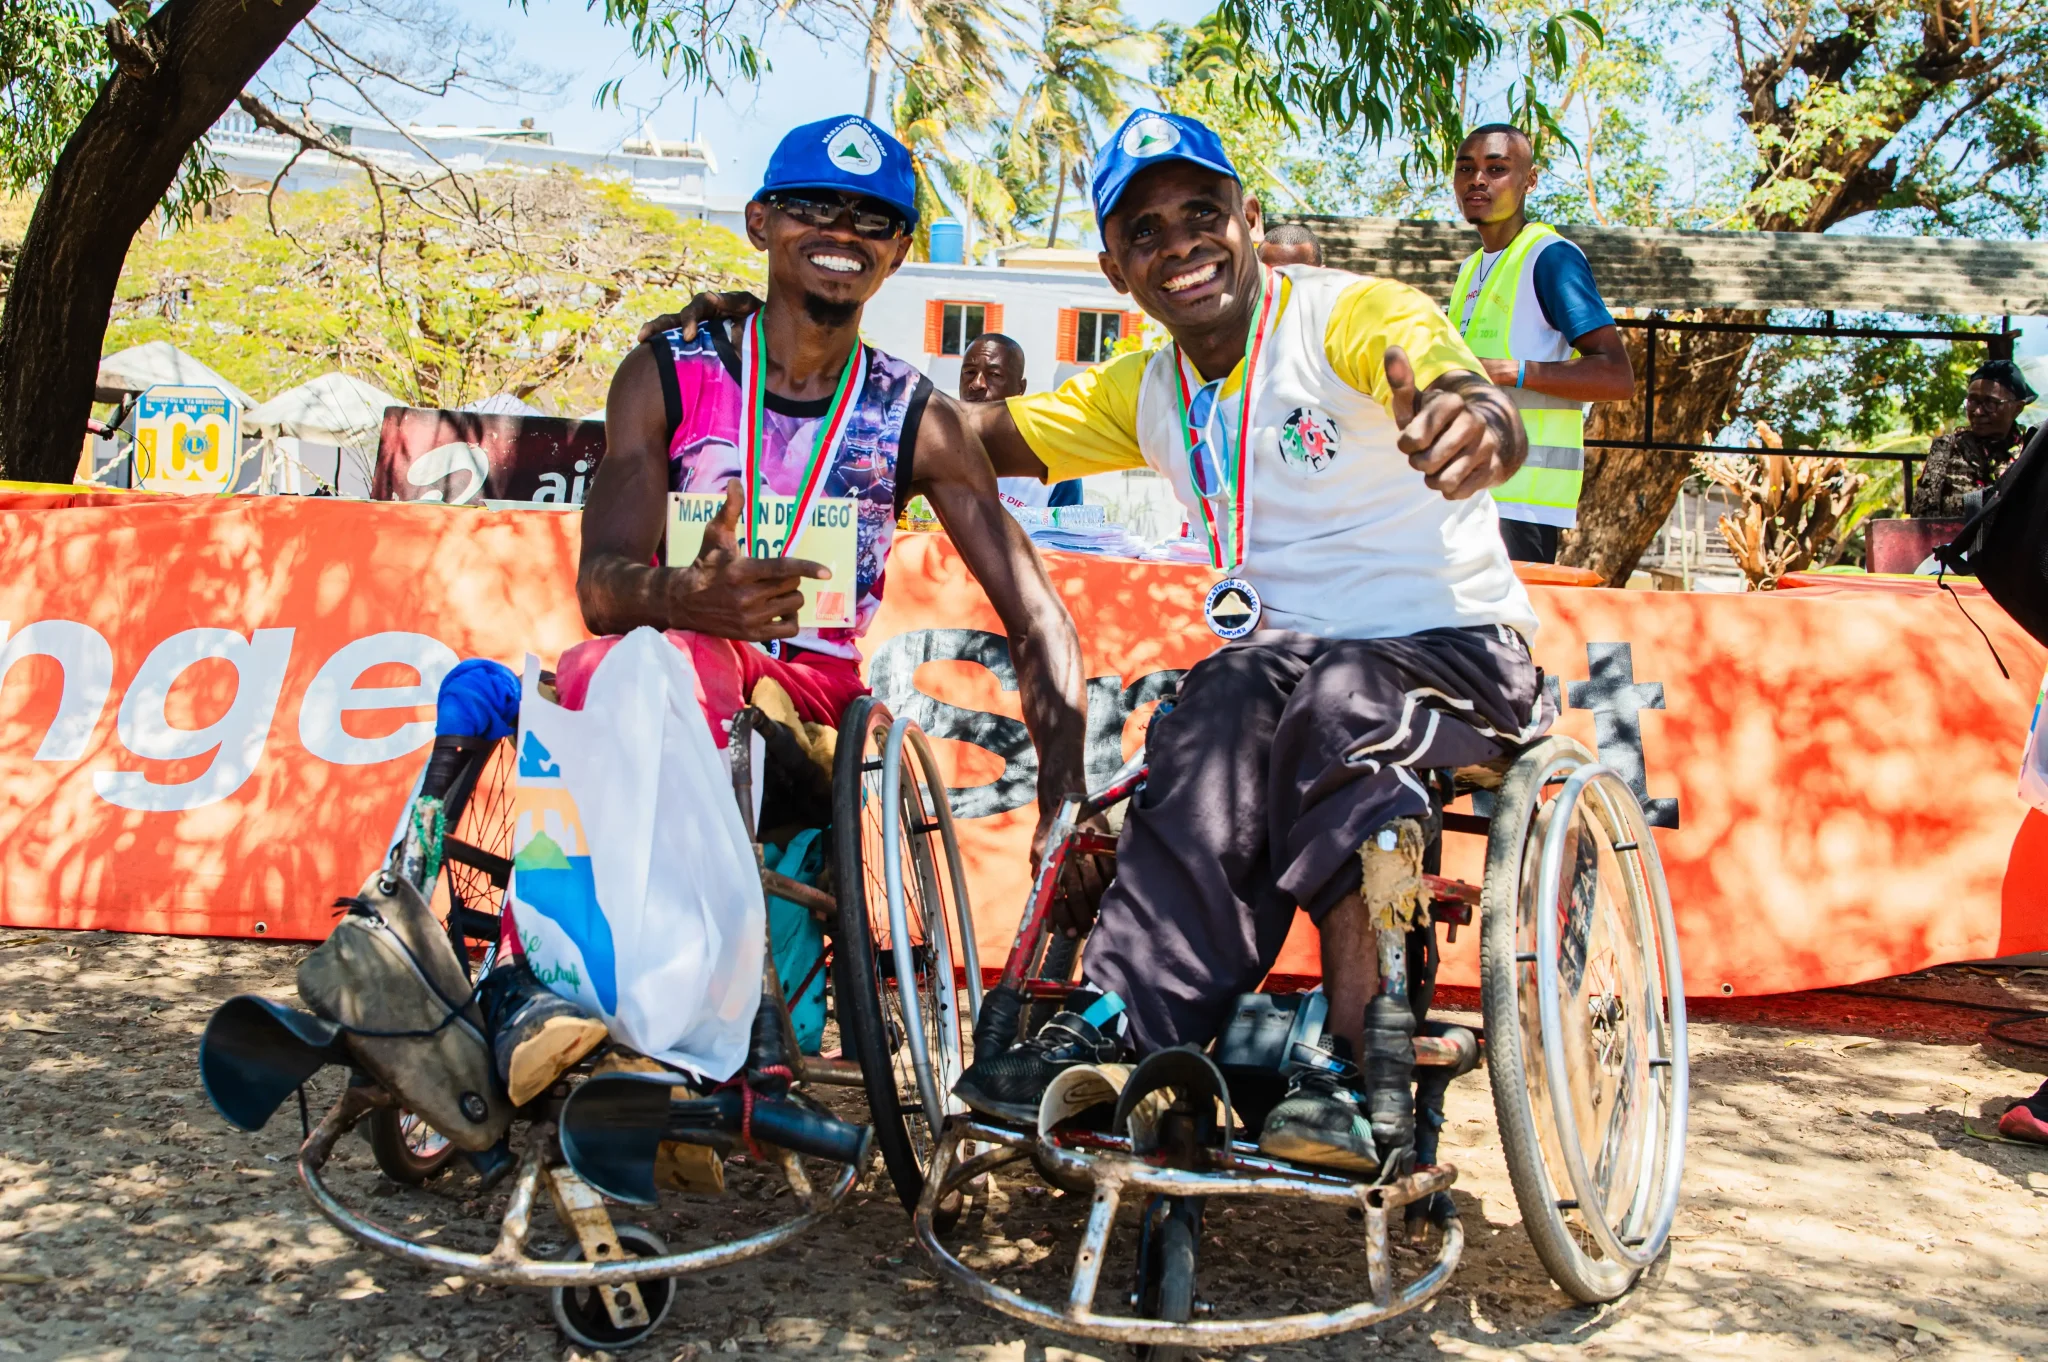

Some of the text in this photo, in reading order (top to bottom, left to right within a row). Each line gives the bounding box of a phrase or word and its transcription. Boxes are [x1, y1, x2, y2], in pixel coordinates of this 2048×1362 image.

[821, 117, 888, 157] MARATHON DE DIEGO
[1117, 113, 1147, 150] MARATHON
[184, 405, 197, 413] UN
[201, 405, 224, 414] LION
[1007, 495, 1027, 508] DIE
[808, 505, 850, 528] IEGO
[1205, 580, 1258, 615] MARATHON DE DIEGO
[1218, 626, 1247, 636] FINISHER
